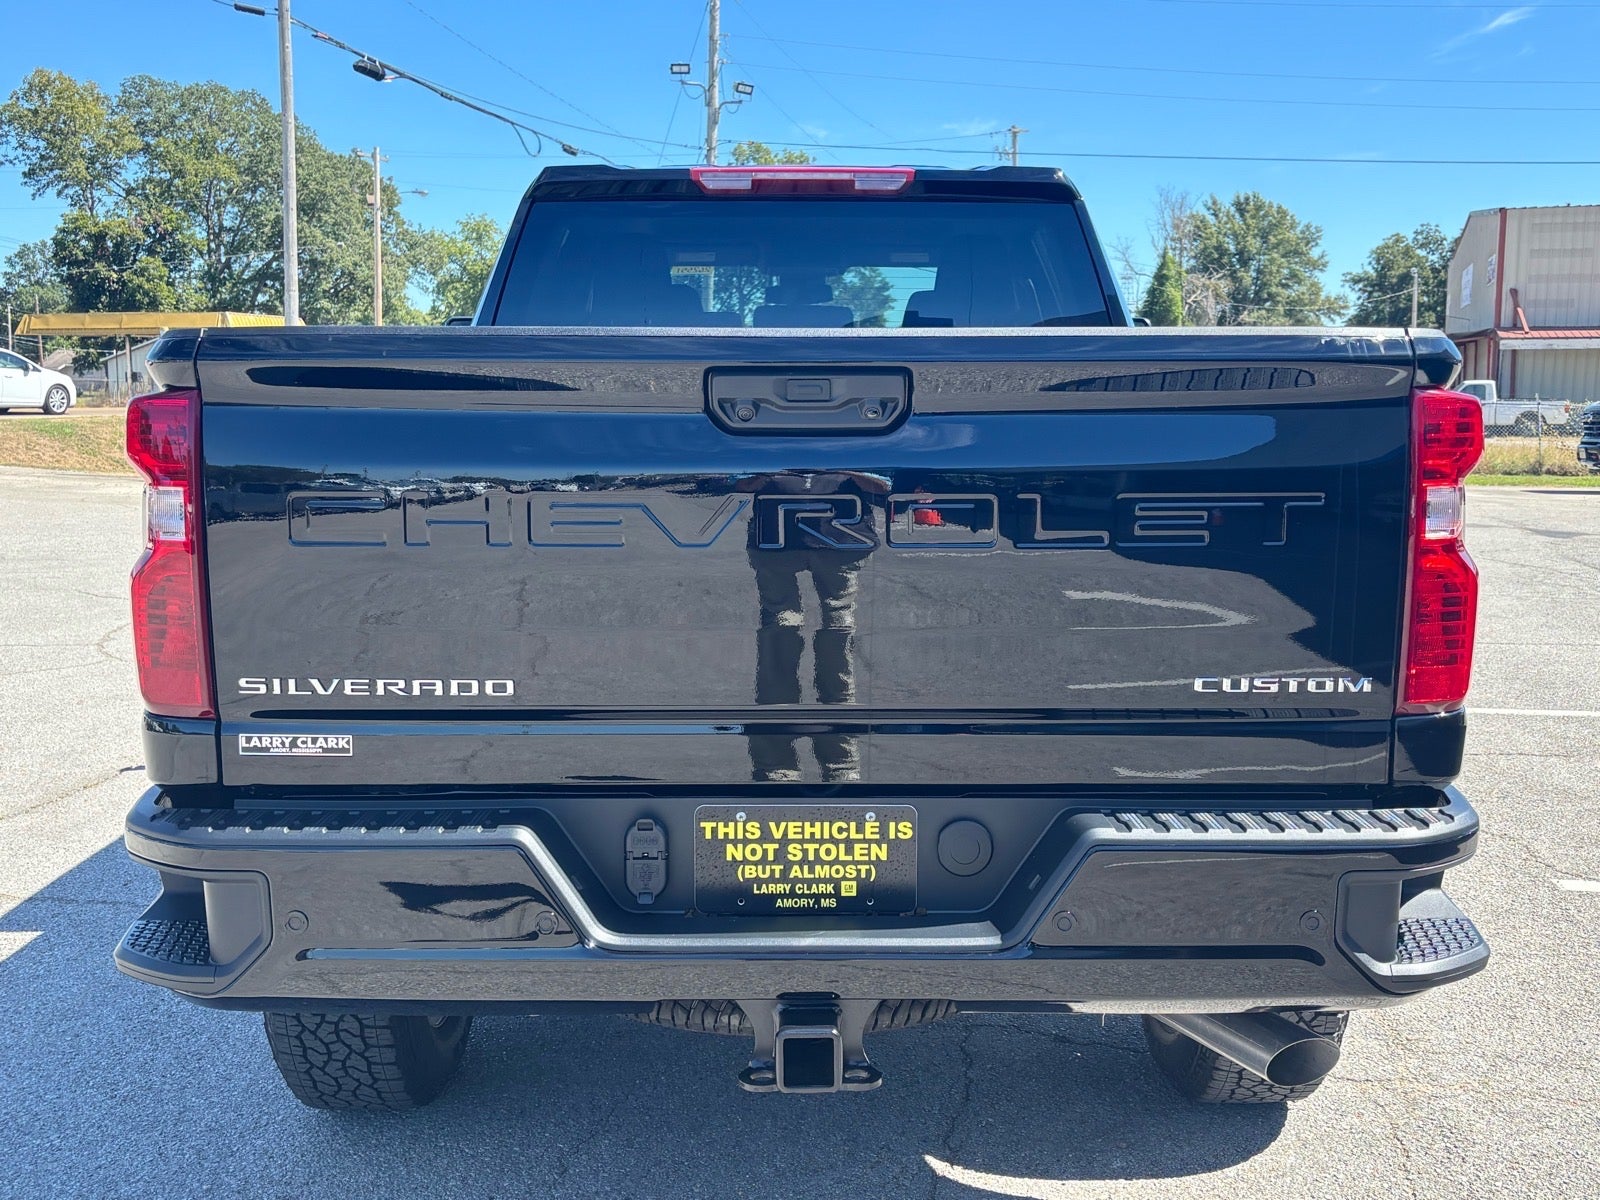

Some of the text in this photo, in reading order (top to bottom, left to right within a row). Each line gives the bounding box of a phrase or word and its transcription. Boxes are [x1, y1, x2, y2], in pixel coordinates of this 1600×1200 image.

[287, 490, 1326, 549] CHEVROLET
[238, 677, 515, 696] SILVERADO
[1193, 677, 1373, 693] CUSTOM
[241, 736, 350, 749] LARRY CLARK
[700, 821, 914, 839] THIS VEHICLE IS
[726, 843, 888, 861] NOT STOLEN
[737, 864, 876, 882] (BUT ALMOST)
[753, 883, 835, 895] LARRY CLARK
[775, 898, 837, 910] AMORY, MS
